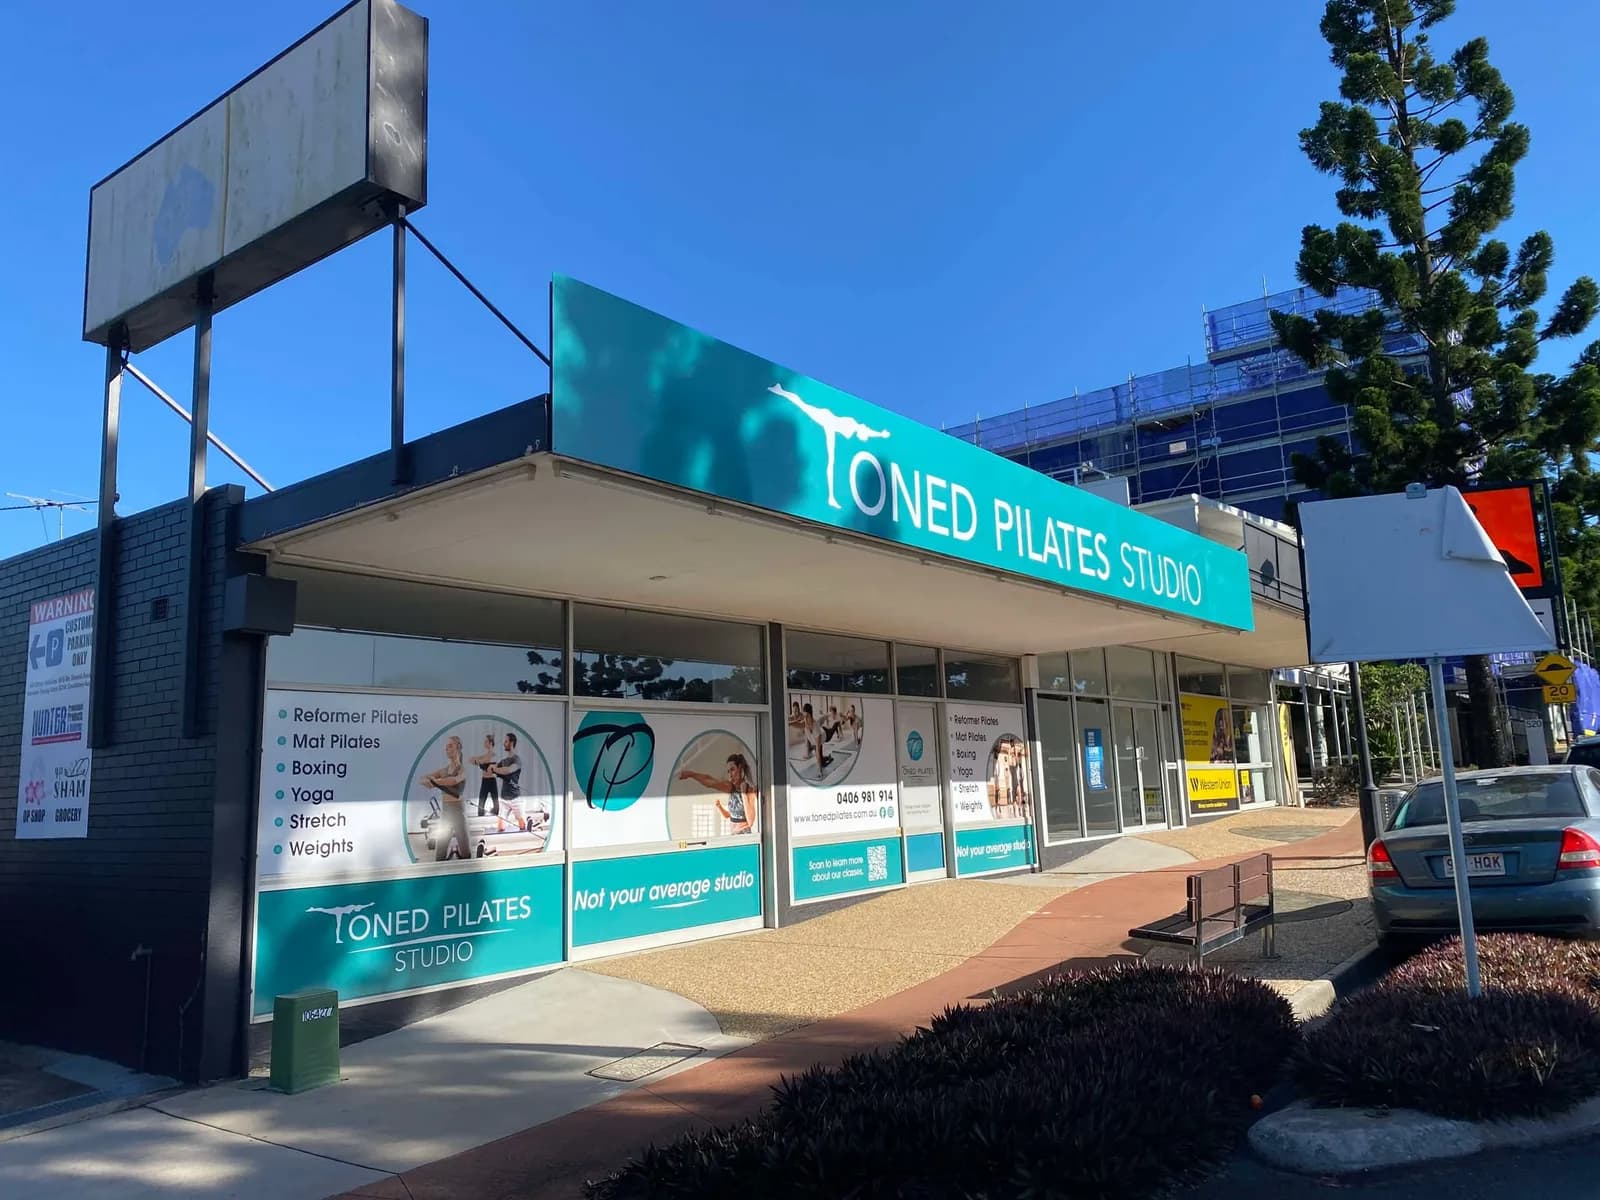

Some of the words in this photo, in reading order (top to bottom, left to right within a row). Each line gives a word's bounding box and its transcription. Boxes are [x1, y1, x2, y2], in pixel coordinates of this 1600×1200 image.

[768, 383, 978, 541] TONED
[994, 499, 1111, 581] PILATES
[1120, 541, 1202, 606] STUDIO
[67, 634, 91, 651] PARKIN
[1549, 686, 1569, 697] 20
[294, 707, 366, 723] Reformer
[371, 708, 419, 725] Pilates
[954, 714, 980, 726] Reformer
[981, 716, 999, 726] Pilates
[293, 733, 325, 749] Mat
[330, 734, 381, 749] Pilates
[955, 731, 967, 742] Mat
[968, 732, 987, 742] Pilates
[956, 749, 976, 760] Boxing
[292, 760, 347, 778] Boxing
[957, 766, 973, 778] Yoga
[54, 780, 86, 799] SHAM
[291, 787, 334, 805] Yoga
[837, 792, 859, 804] 0406
[861, 790, 876, 803] 981
[879, 789, 893, 802] 914
[958, 784, 979, 793] Stretch
[960, 800, 983, 812] Weights
[290, 812, 346, 829] Stretch
[793, 810, 877, 823] www.tonedpilates.com.au
[289, 839, 354, 858] Weights
[985, 841, 1012, 855] average
[1013, 839, 1031, 851] studo
[809, 860, 825, 870] Scan
[574, 887, 605, 911] Not
[609, 886, 646, 911] your
[649, 878, 711, 899] average
[714, 870, 754, 892] studio
[305, 902, 430, 944] TONED
[443, 895, 532, 929] PILATES
[395, 941, 473, 972] STUDIO
